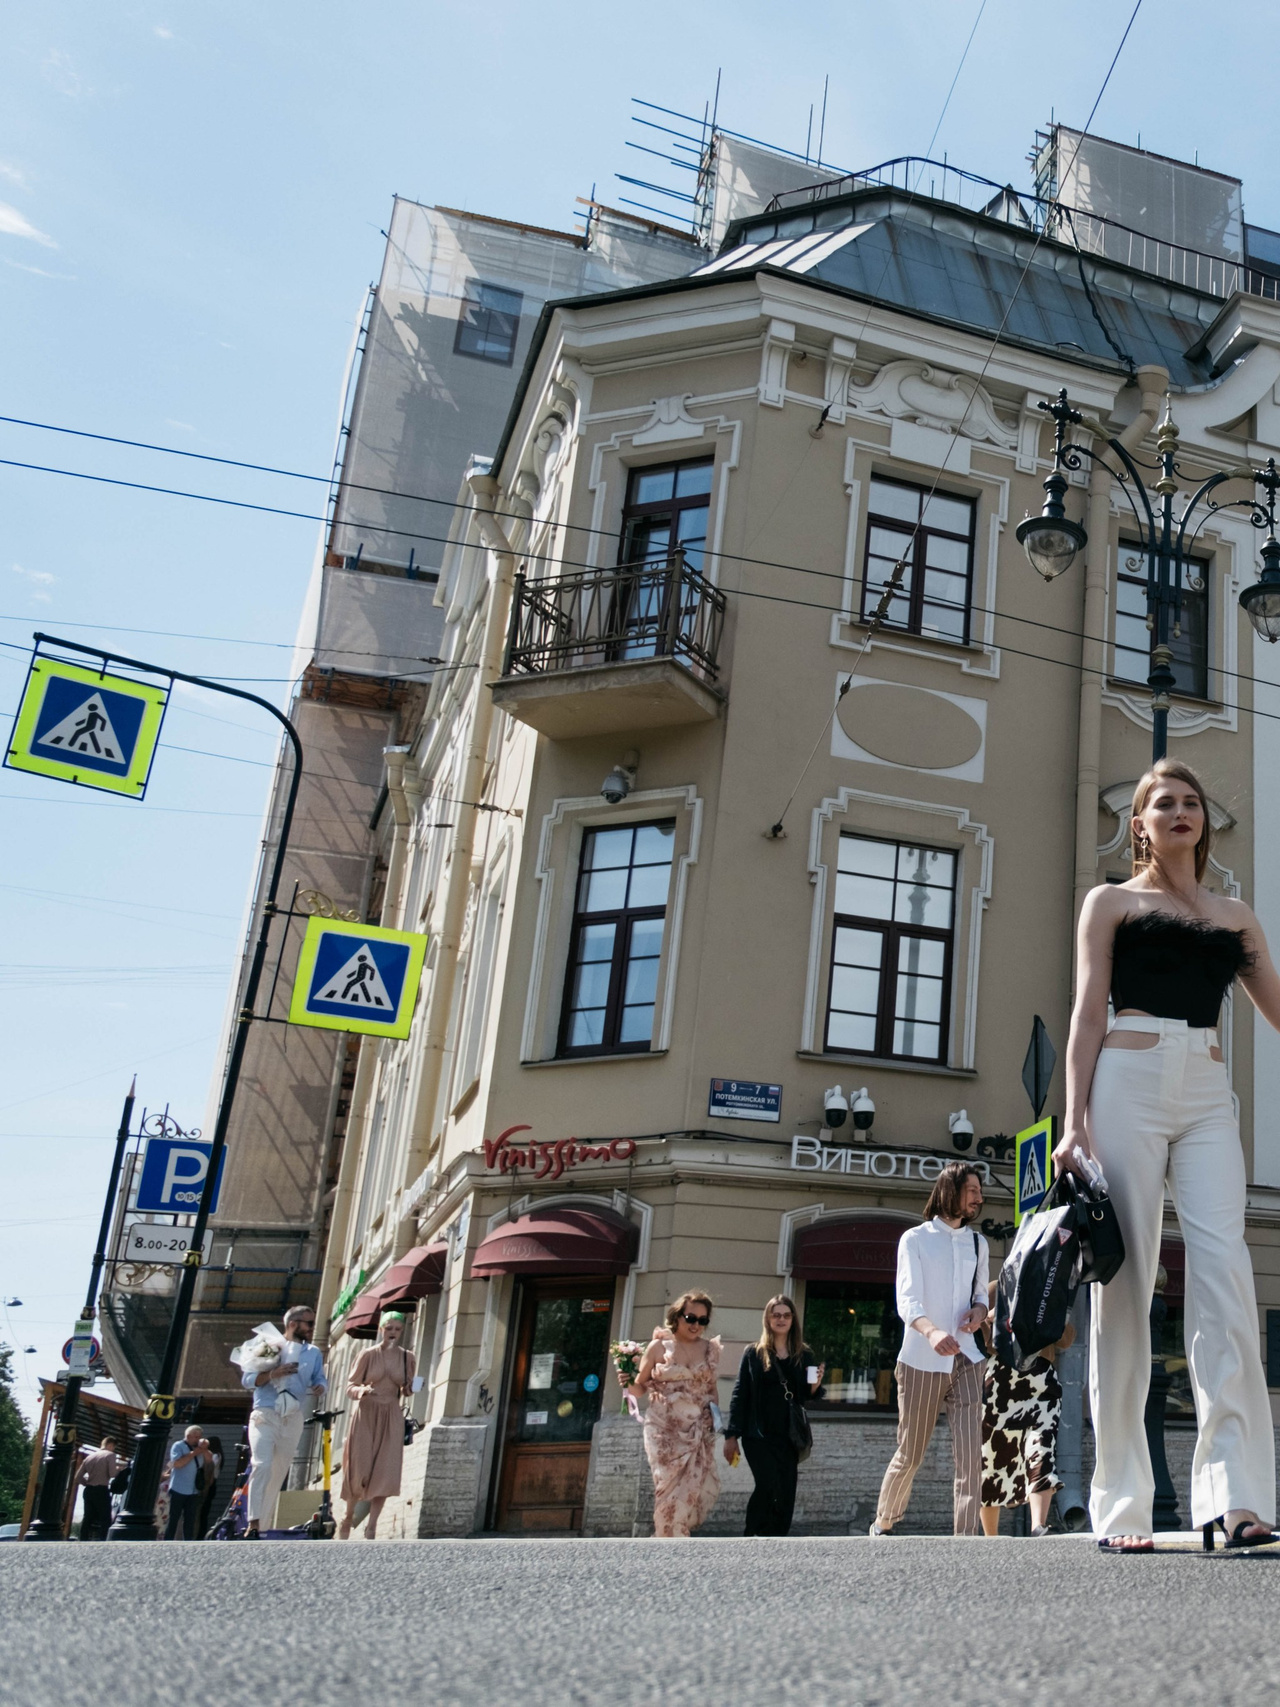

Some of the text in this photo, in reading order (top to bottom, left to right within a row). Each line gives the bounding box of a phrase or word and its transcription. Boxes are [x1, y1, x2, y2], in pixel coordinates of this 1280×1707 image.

[715, 1093, 765, 1104] ПОТЕМКИНСКАЯ
[731, 1083, 761, 1094] 9 7
[160, 1148, 209, 1204] P
[484, 1124, 636, 1180] Vinissimo
[790, 1135, 993, 1186] Винотеа
[186, 1193, 194, 1201] 15
[1036, 1250, 1062, 1324] SHOP GUESS.com
